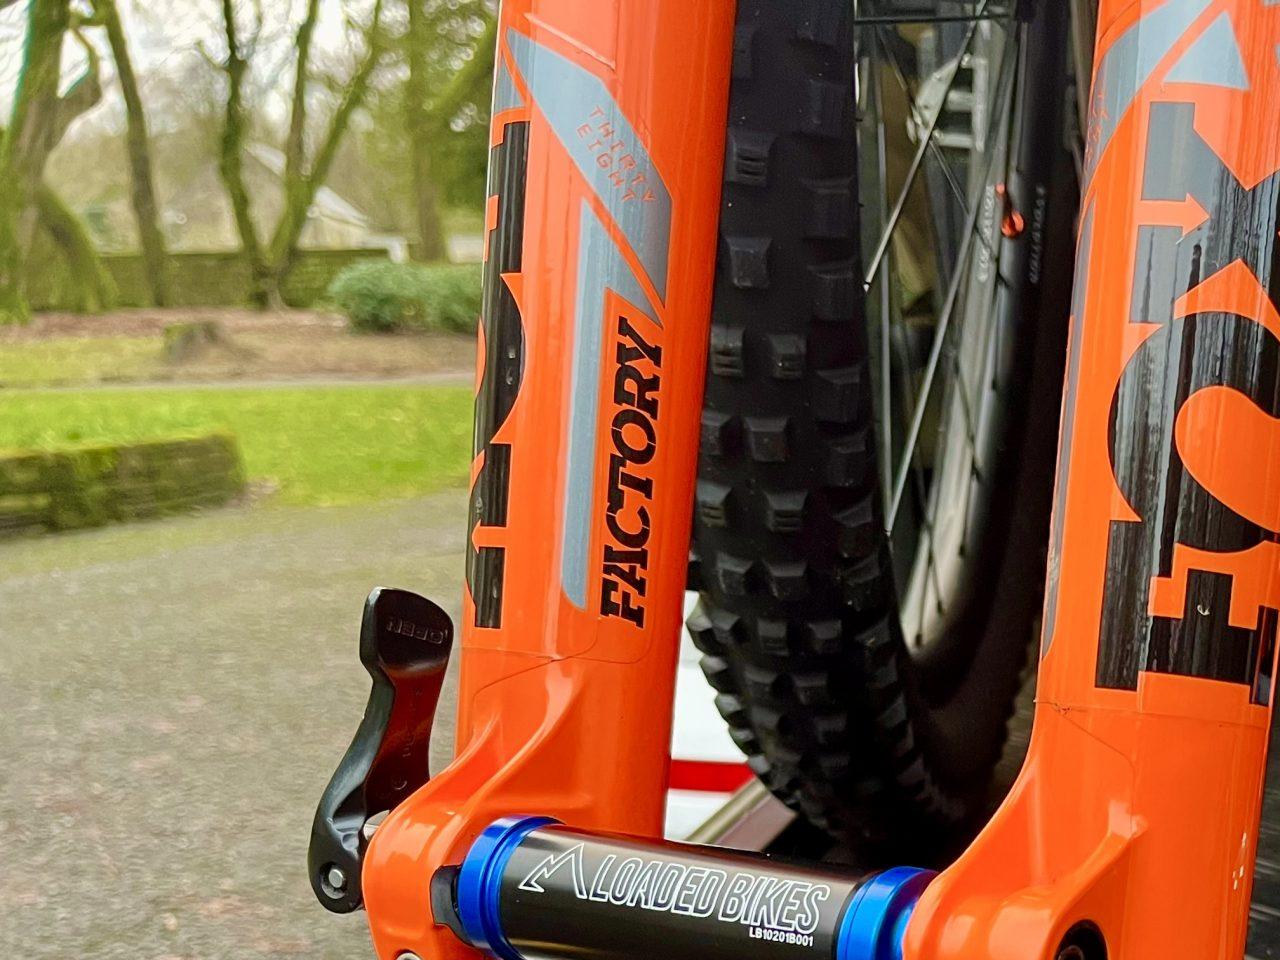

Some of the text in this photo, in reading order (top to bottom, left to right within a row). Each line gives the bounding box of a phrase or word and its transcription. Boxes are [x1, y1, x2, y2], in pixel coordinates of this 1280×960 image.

[576, 124, 636, 203] EIGHT
[588, 106, 657, 204] THIRTY
[599, 314, 664, 629] FACTORY
[590, 854, 830, 934] LOADED BIKES
[749, 926, 814, 948] LB10201B001
